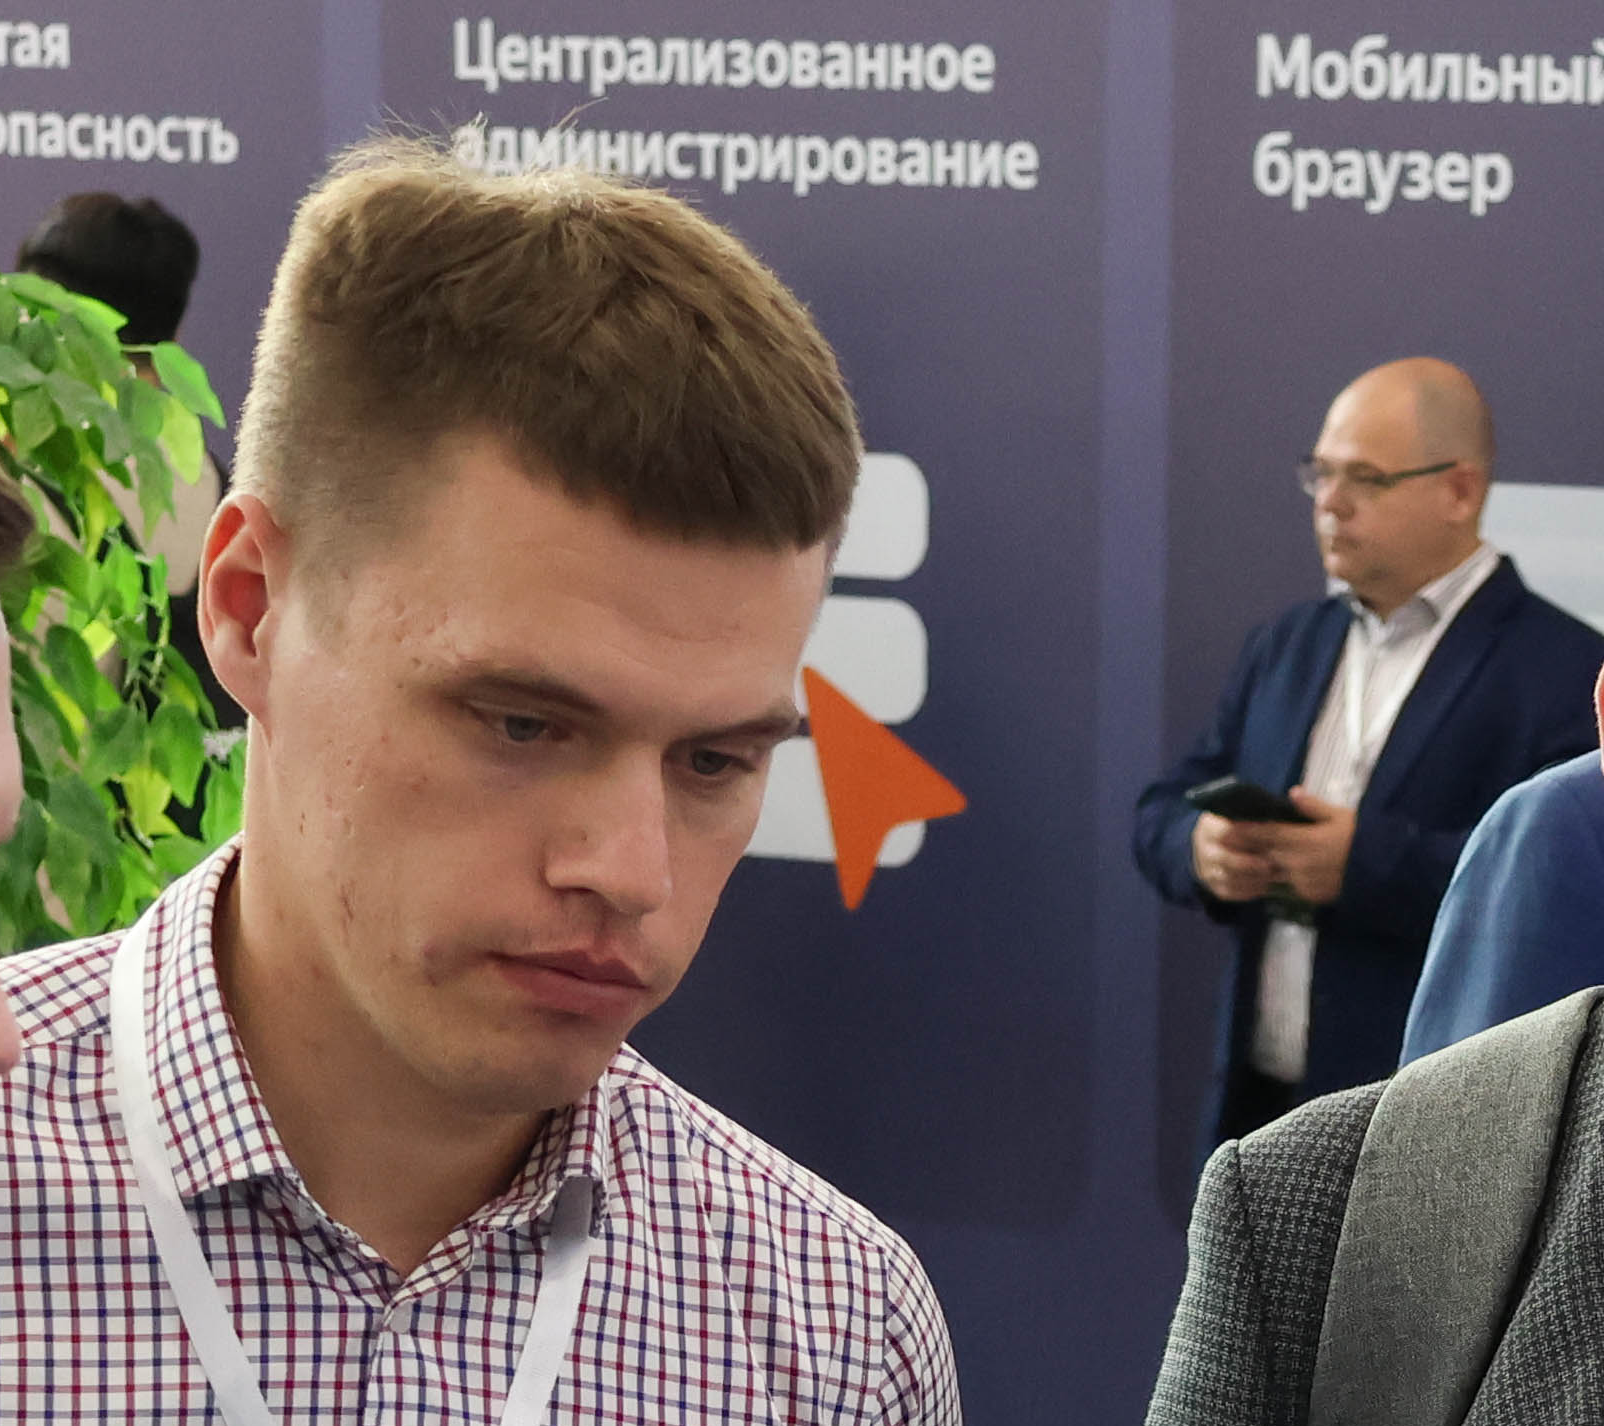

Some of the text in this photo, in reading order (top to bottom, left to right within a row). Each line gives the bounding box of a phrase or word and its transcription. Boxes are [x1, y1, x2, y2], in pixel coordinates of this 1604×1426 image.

[452, 18, 995, 96] Централизованное
[454, 120, 1040, 196] администрирование
[1253, 130, 1514, 216] браузер
